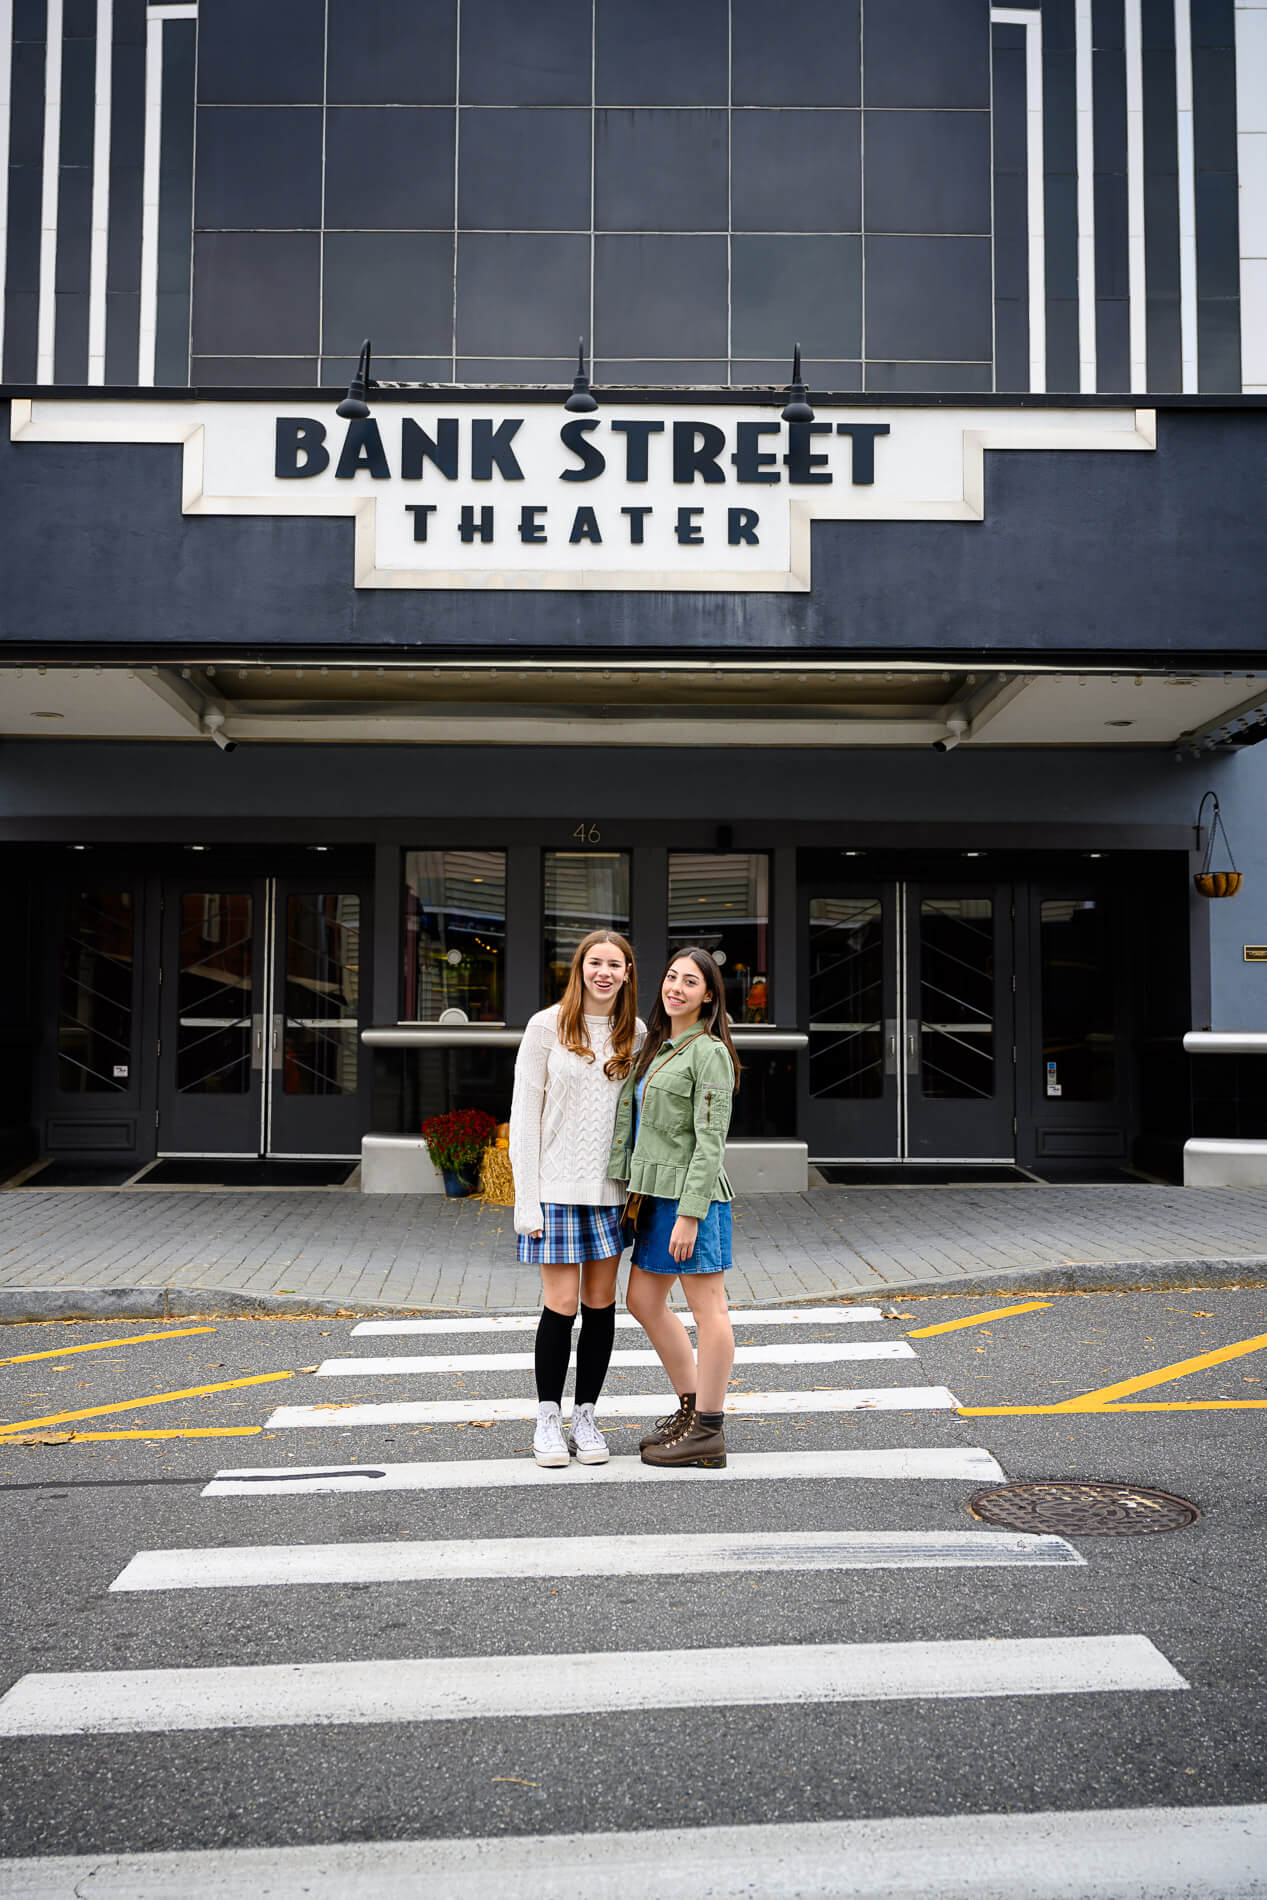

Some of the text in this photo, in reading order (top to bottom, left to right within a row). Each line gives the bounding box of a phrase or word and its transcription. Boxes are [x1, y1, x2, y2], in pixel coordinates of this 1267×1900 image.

[275, 417, 891, 485] BANK STREET
[405, 505, 760, 545] THEATER
[572, 823, 601, 844] 46
